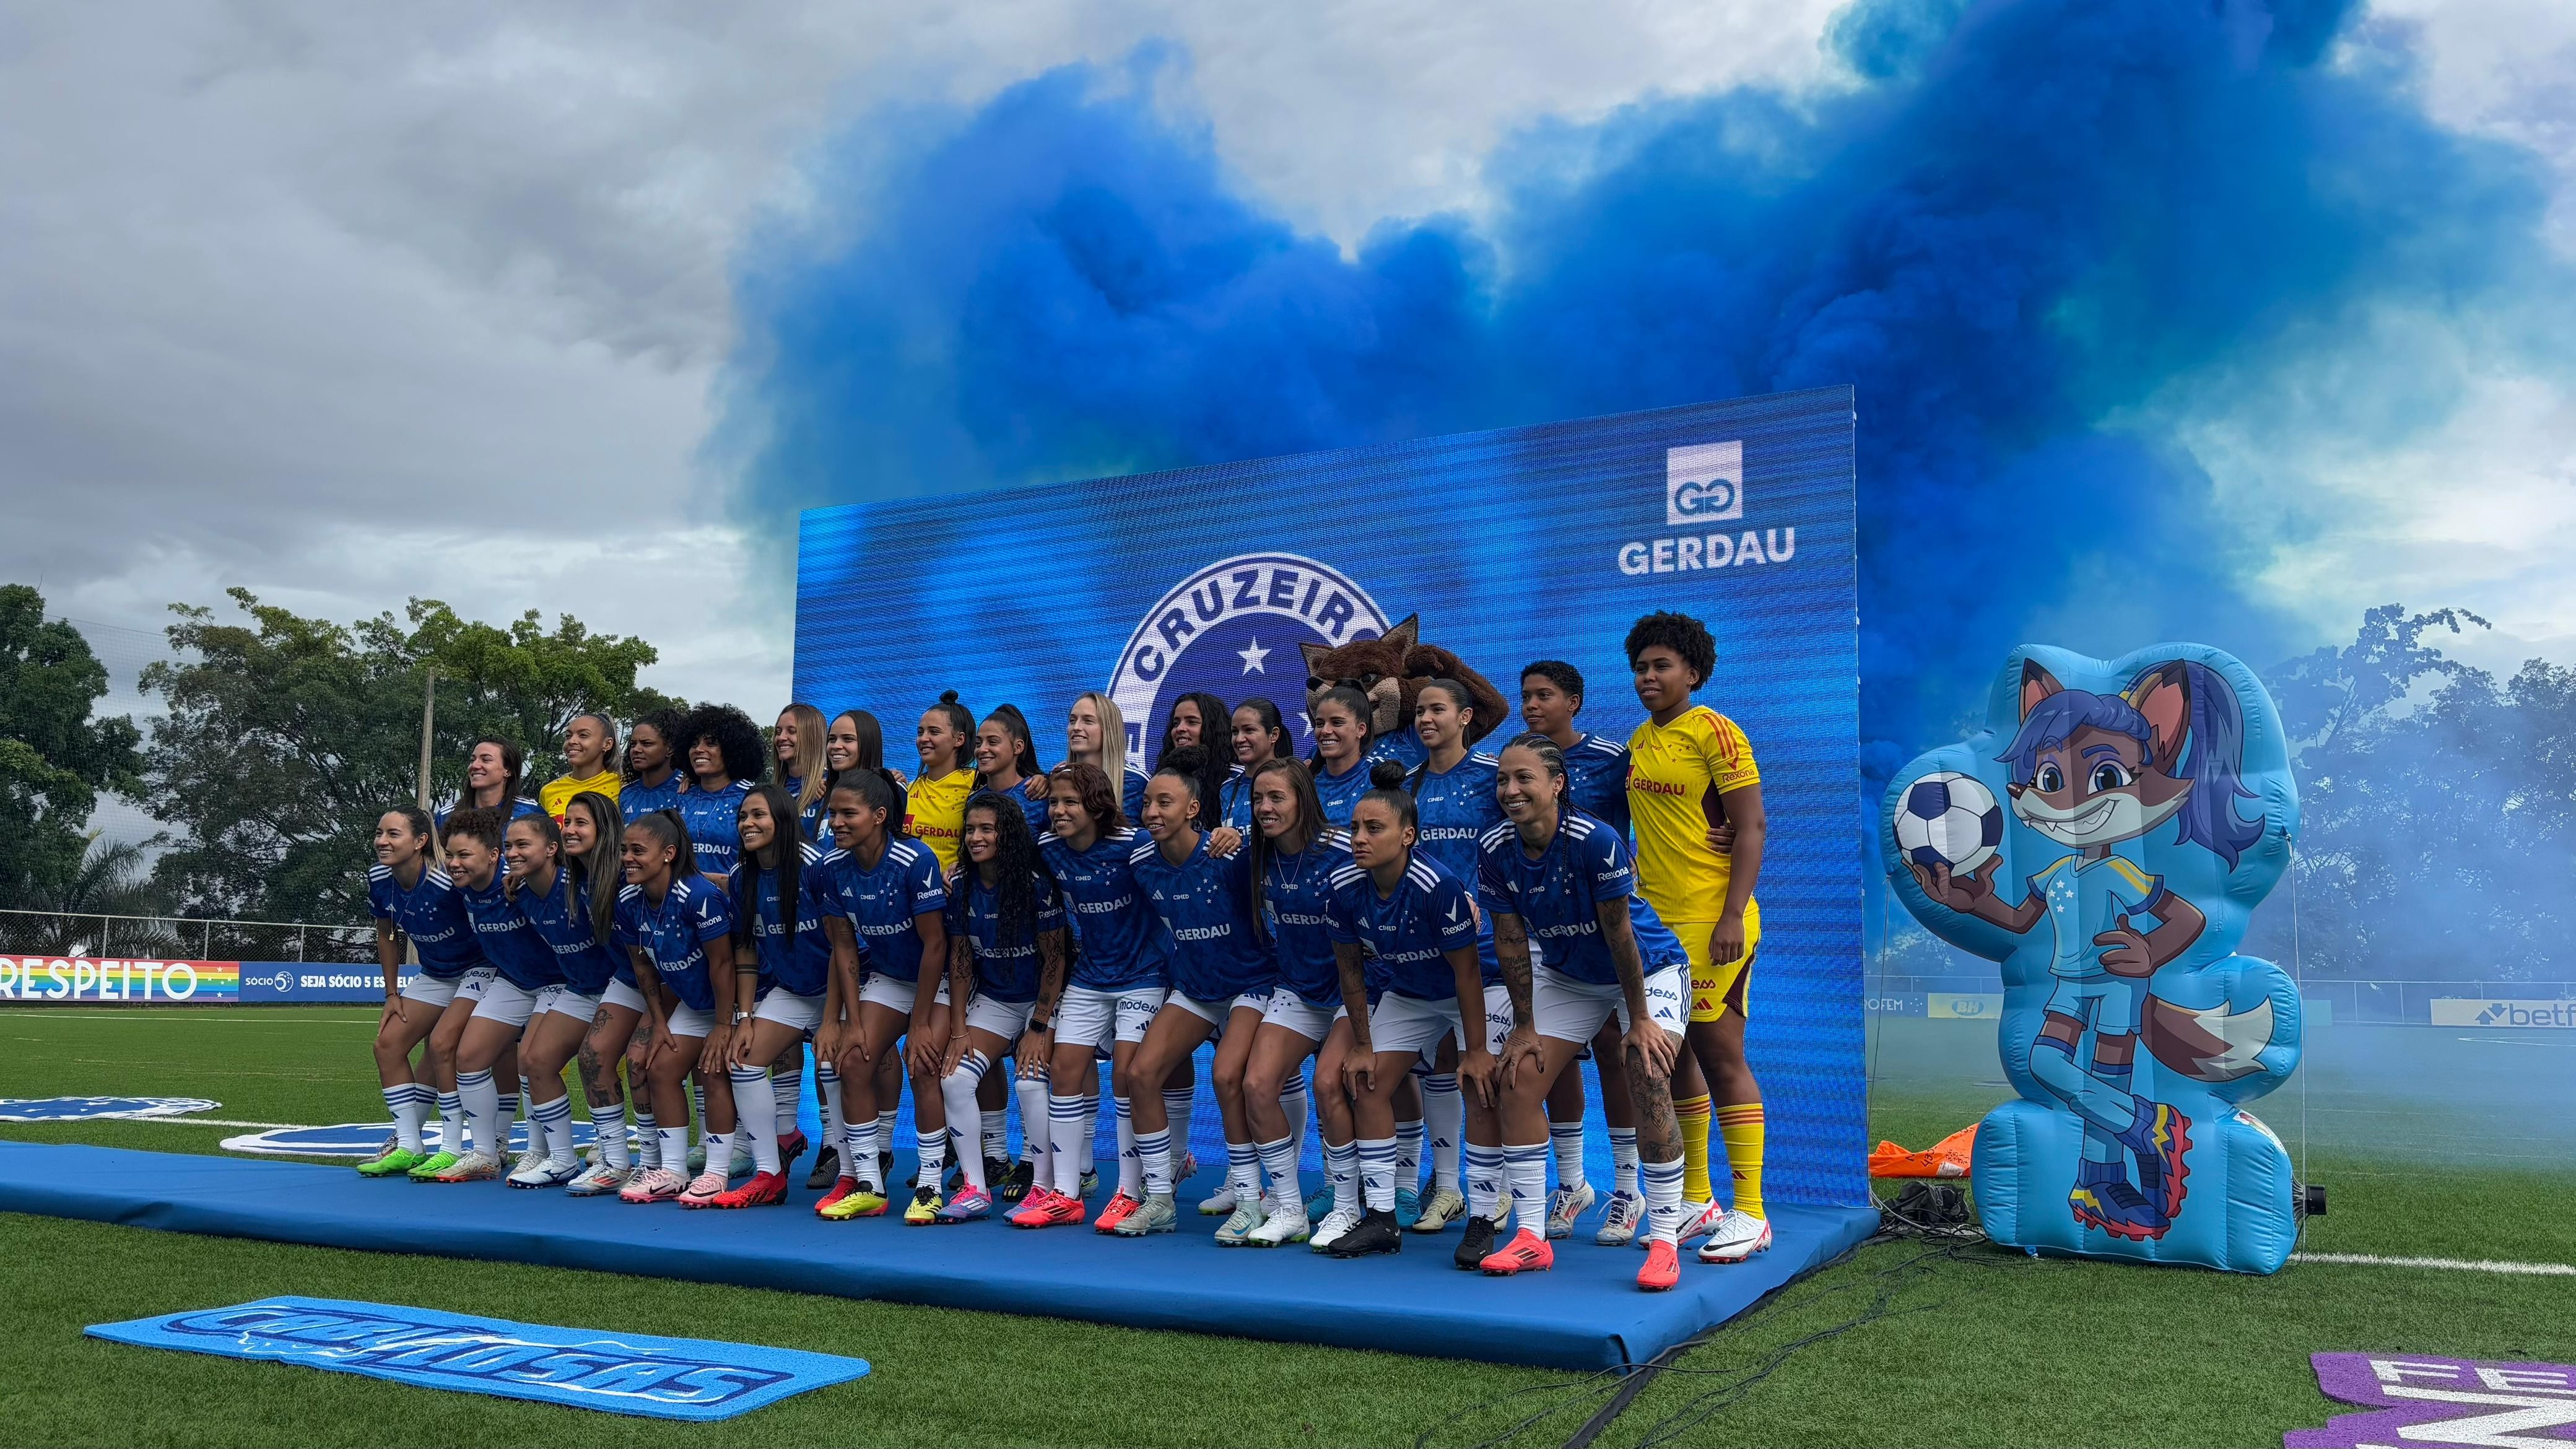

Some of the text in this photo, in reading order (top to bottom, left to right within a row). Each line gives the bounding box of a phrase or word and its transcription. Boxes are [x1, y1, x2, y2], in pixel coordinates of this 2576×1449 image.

[1617, 528, 1795, 575] GERDAU
[1722, 768, 1755, 783] Rexona
[1633, 777, 1685, 796] GERDAU
[1421, 828, 1478, 841] GERDAU
[693, 843, 731, 855] ERDAU
[1598, 866, 1629, 882] Rexona
[917, 888, 943, 900] Rexona
[1477, 883, 1495, 895] exona
[1078, 894, 1132, 913] GERDAU
[479, 916, 526, 932] GERDAU
[697, 915, 722, 929] Rexona
[768, 919, 817, 934] GEAU
[862, 918, 913, 936] GERDAU
[1281, 913, 1327, 925] GERDA
[1442, 918, 1472, 936] Rexona
[409, 926, 455, 942] GERDAU
[1176, 923, 1230, 941] GERDAU
[552, 936, 594, 954] GERDAU
[1382, 947, 1440, 964] GRDAU
[0, 957, 197, 1000] RESPEITO
[245, 976, 273, 986] SÓCIO
[301, 975, 326, 988] SEJA
[329, 974, 363, 988] SÓCIO
[364, 975, 371, 988] 5
[1645, 987, 1677, 1001] dess
